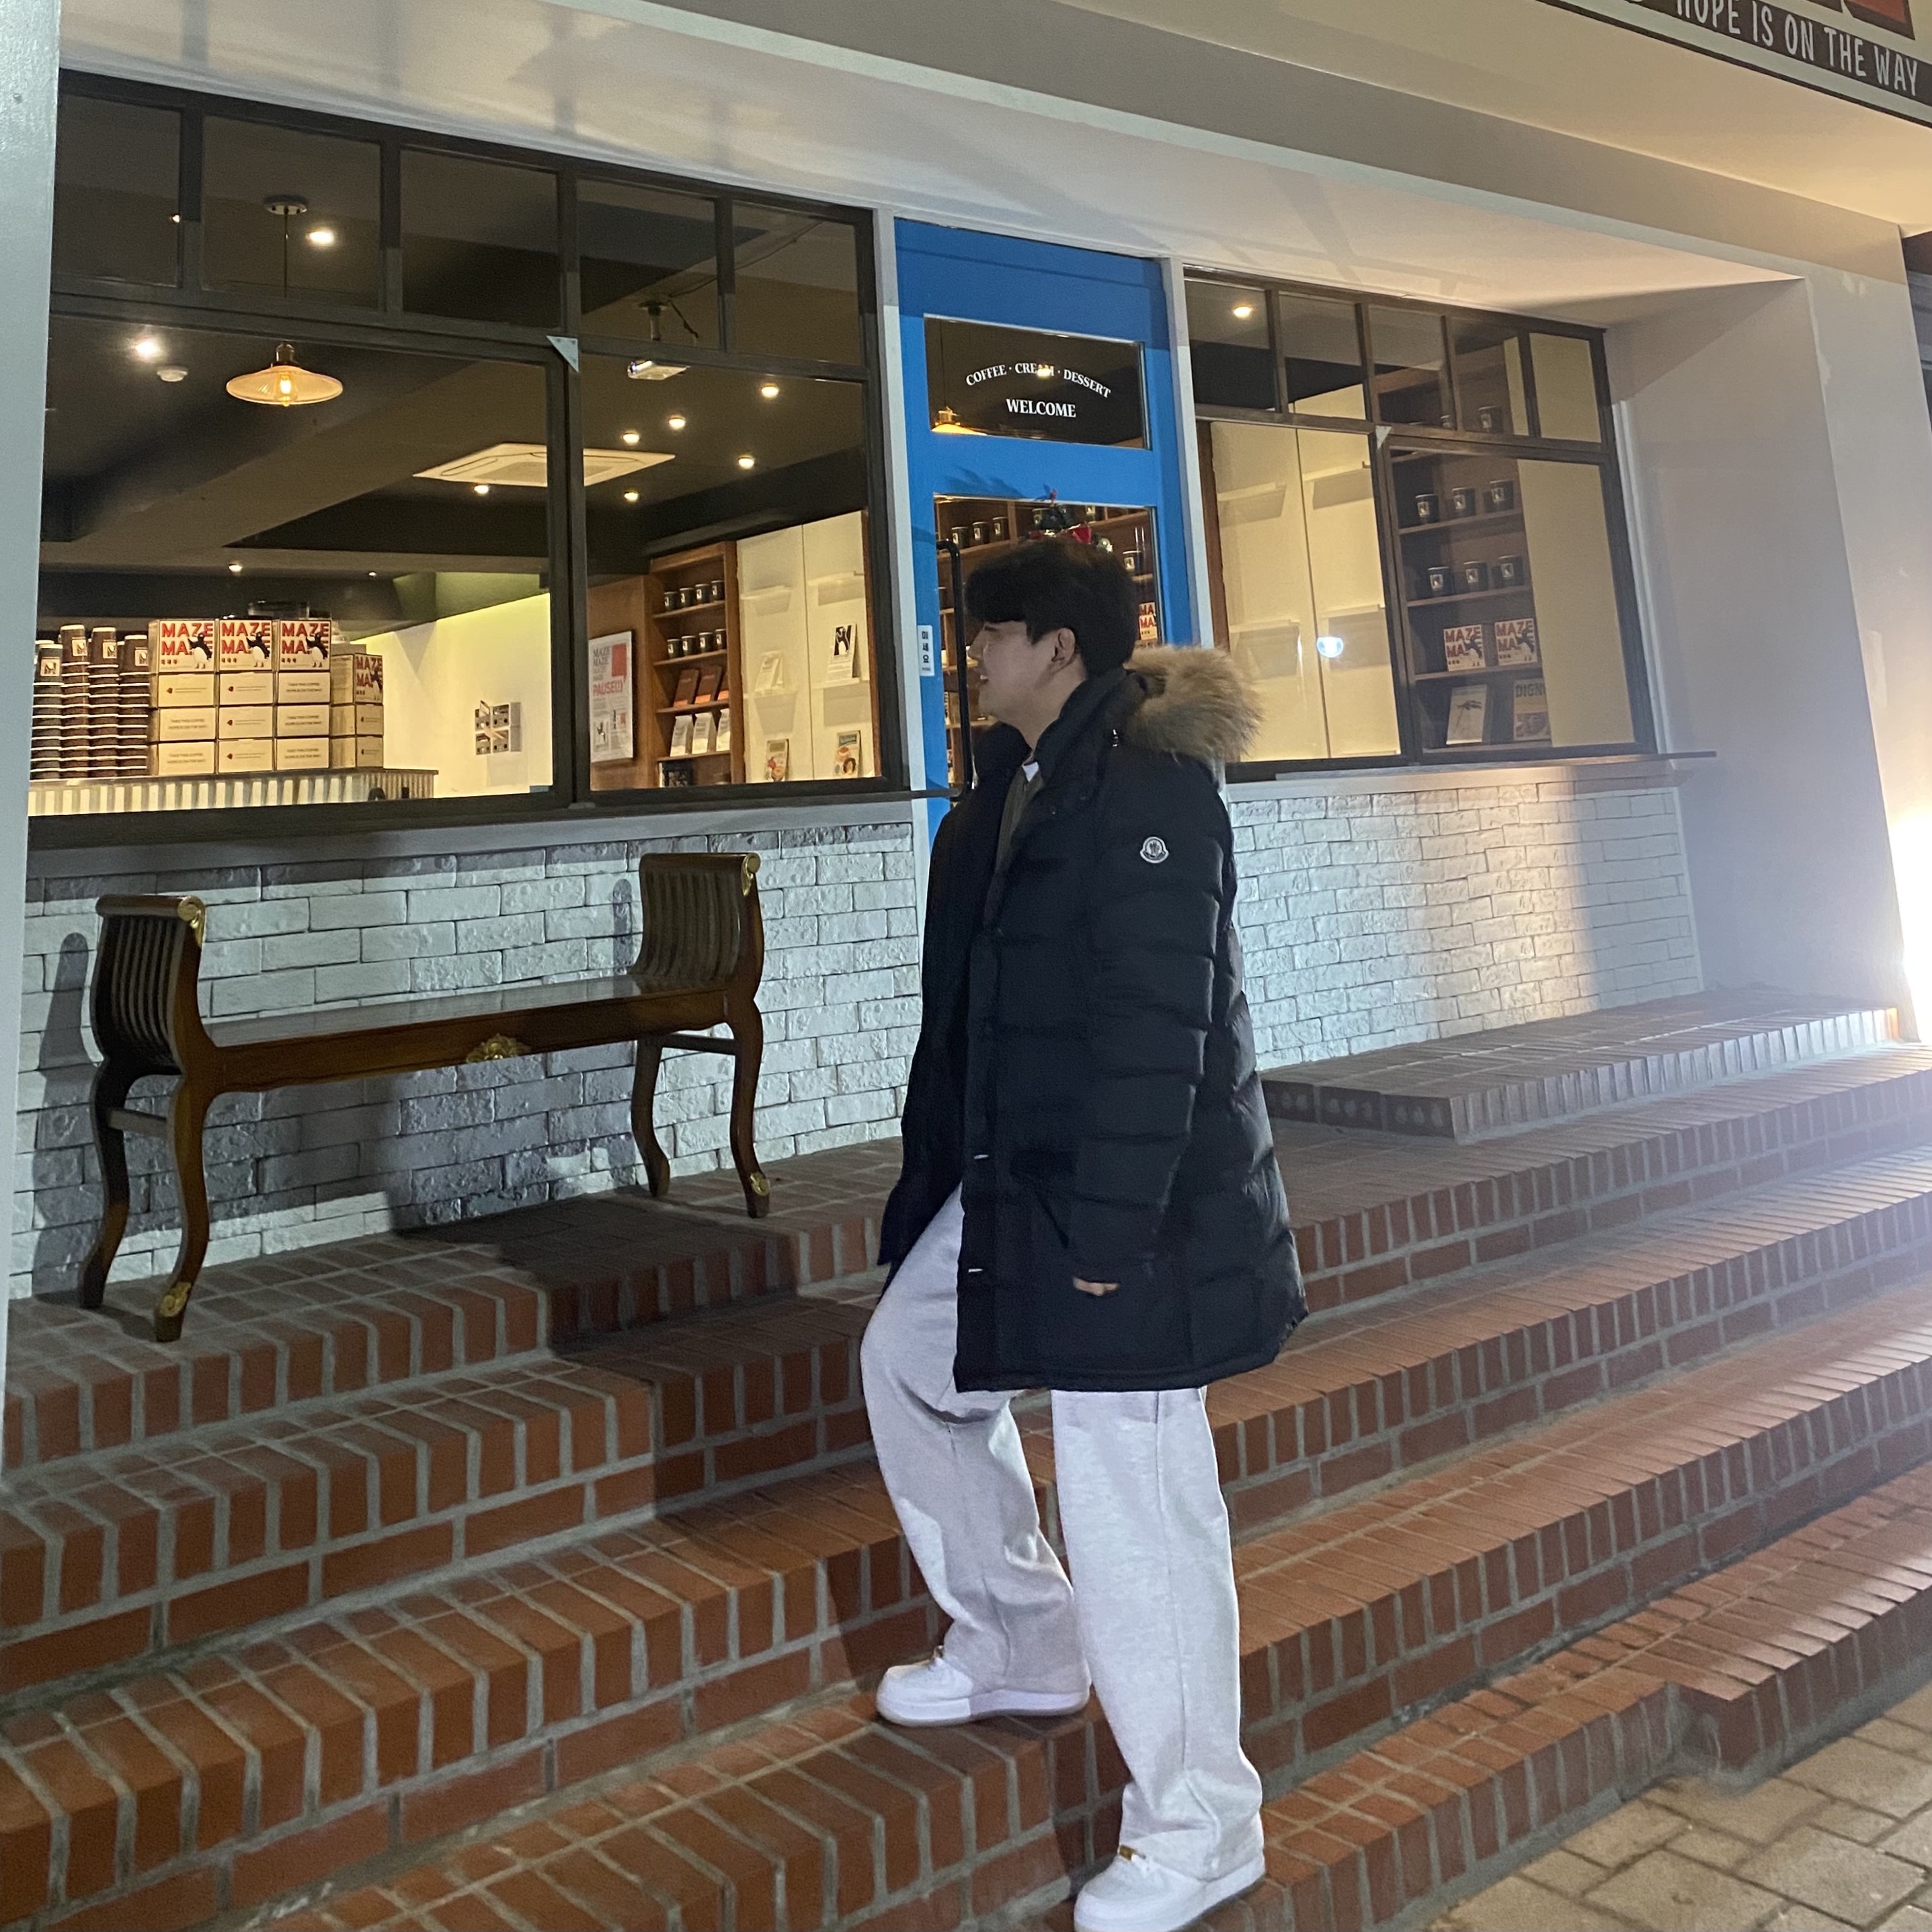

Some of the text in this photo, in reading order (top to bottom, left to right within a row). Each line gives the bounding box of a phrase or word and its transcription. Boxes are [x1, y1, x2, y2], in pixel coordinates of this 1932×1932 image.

[1753, 3, 1774, 46] IS
[1785, 14, 1814, 61] ON
[1824, 27, 1867, 77] THE
[1874, 46, 1918, 96] WAY
[965, 364, 1007, 386] COFFEE
[1063, 369, 1111, 399] DESSERT
[1006, 399, 1076, 417] WELCOME
[161, 622, 213, 637] MAZE
[221, 622, 270, 637] MAZE
[282, 622, 329, 637] MAZE
[1140, 617, 1156, 628] MA
[1496, 620, 1533, 637] MAZE
[1445, 627, 1481, 642] MAZE
[161, 641, 213, 655] MA
[221, 639, 270, 654] MA
[282, 640, 329, 655] MA
